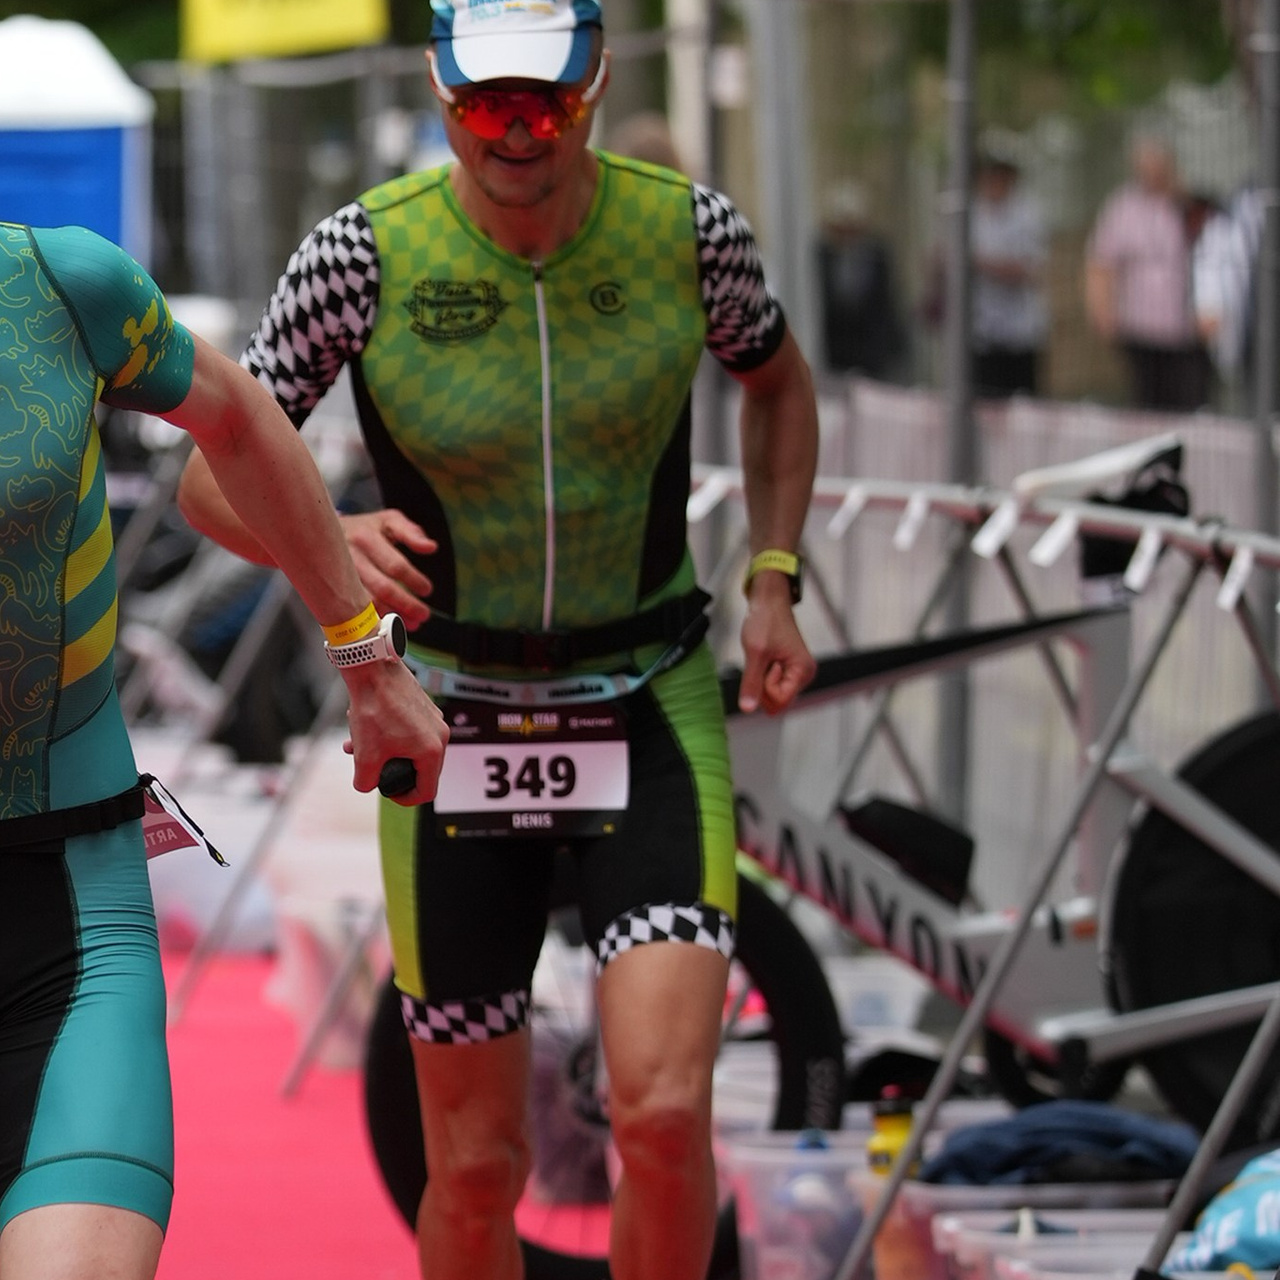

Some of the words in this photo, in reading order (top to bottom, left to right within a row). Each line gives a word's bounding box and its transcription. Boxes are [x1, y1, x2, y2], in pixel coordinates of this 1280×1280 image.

[532, 712, 560, 727] STAR
[483, 756, 577, 800] 349
[511, 812, 553, 829] DENIS
